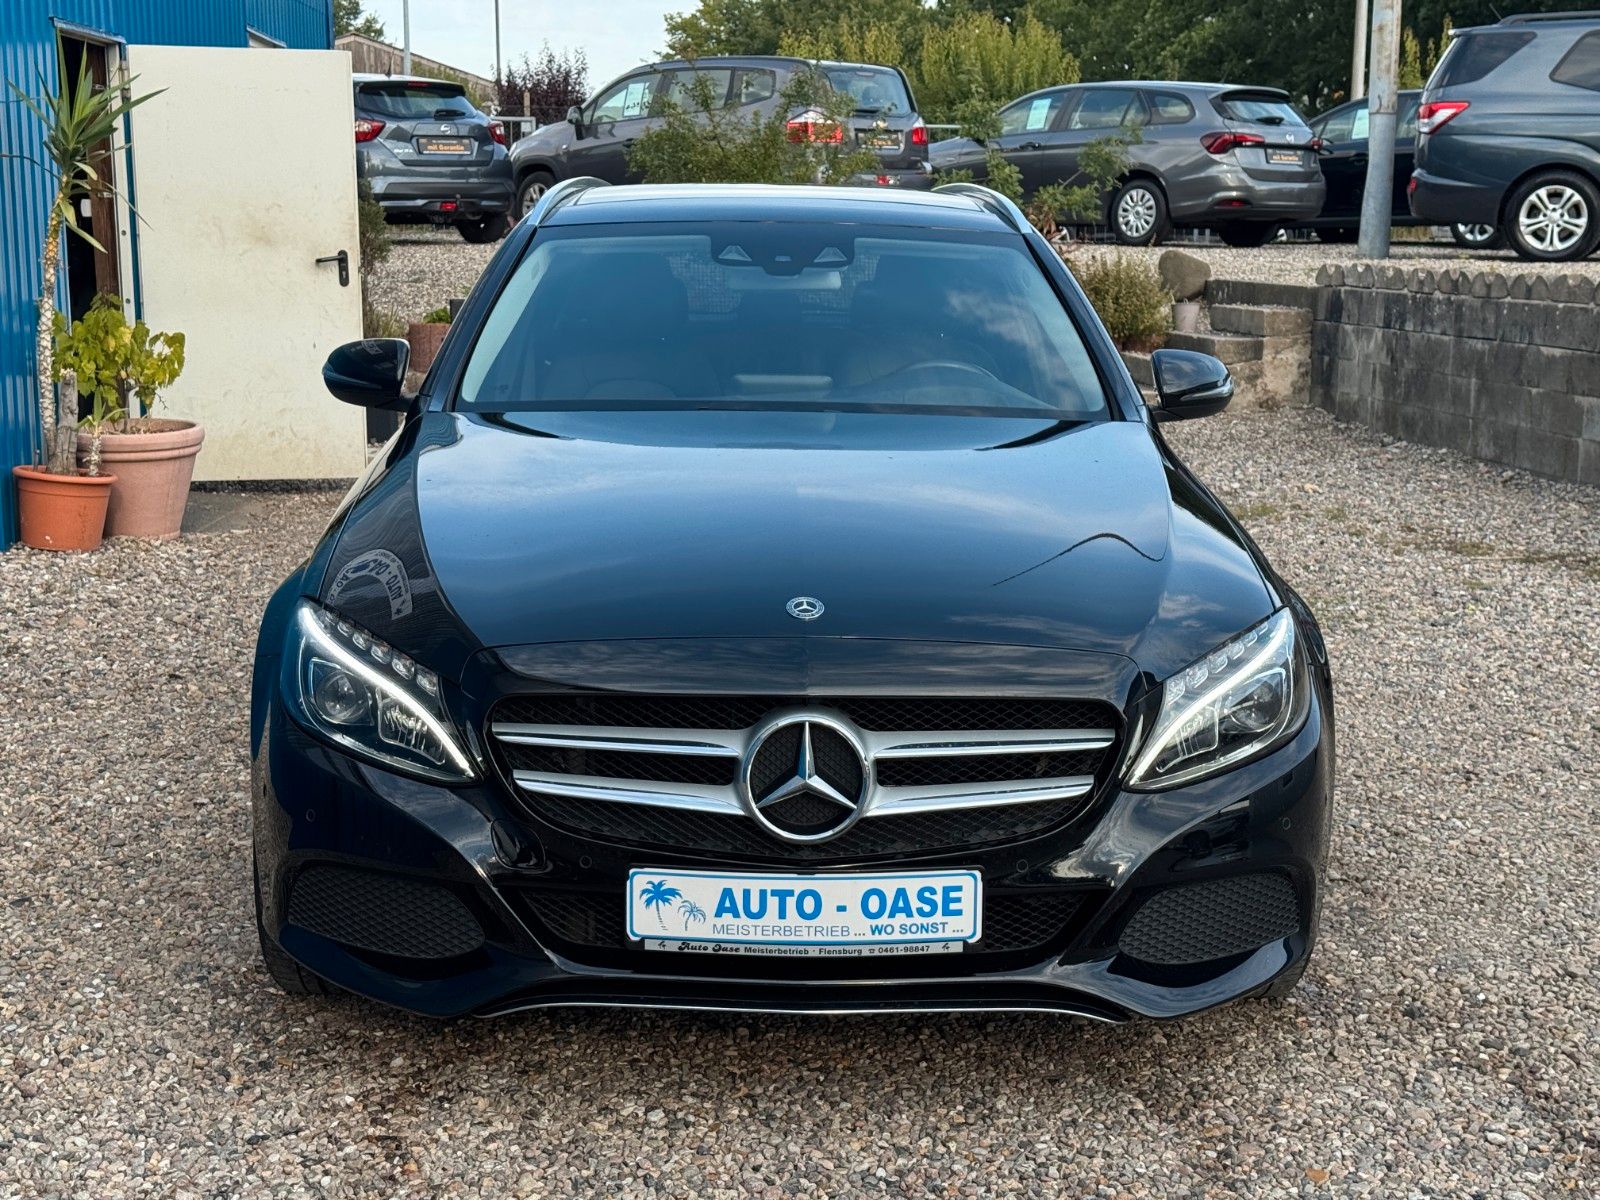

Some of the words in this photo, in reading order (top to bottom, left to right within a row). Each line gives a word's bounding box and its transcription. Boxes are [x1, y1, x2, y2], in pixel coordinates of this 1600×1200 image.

[714, 887, 823, 921] AUTO
[860, 885, 963, 920] OASE
[712, 923, 850, 937] MEISTERBETRIEB
[870, 924, 895, 936] WO
[898, 922, 949, 935] SONST
[677, 942, 709, 951] Auto
[744, 946, 809, 955] Meisterbetrieb
[818, 948, 863, 956] Flensburg
[878, 945, 930, 954] 0461-98847
